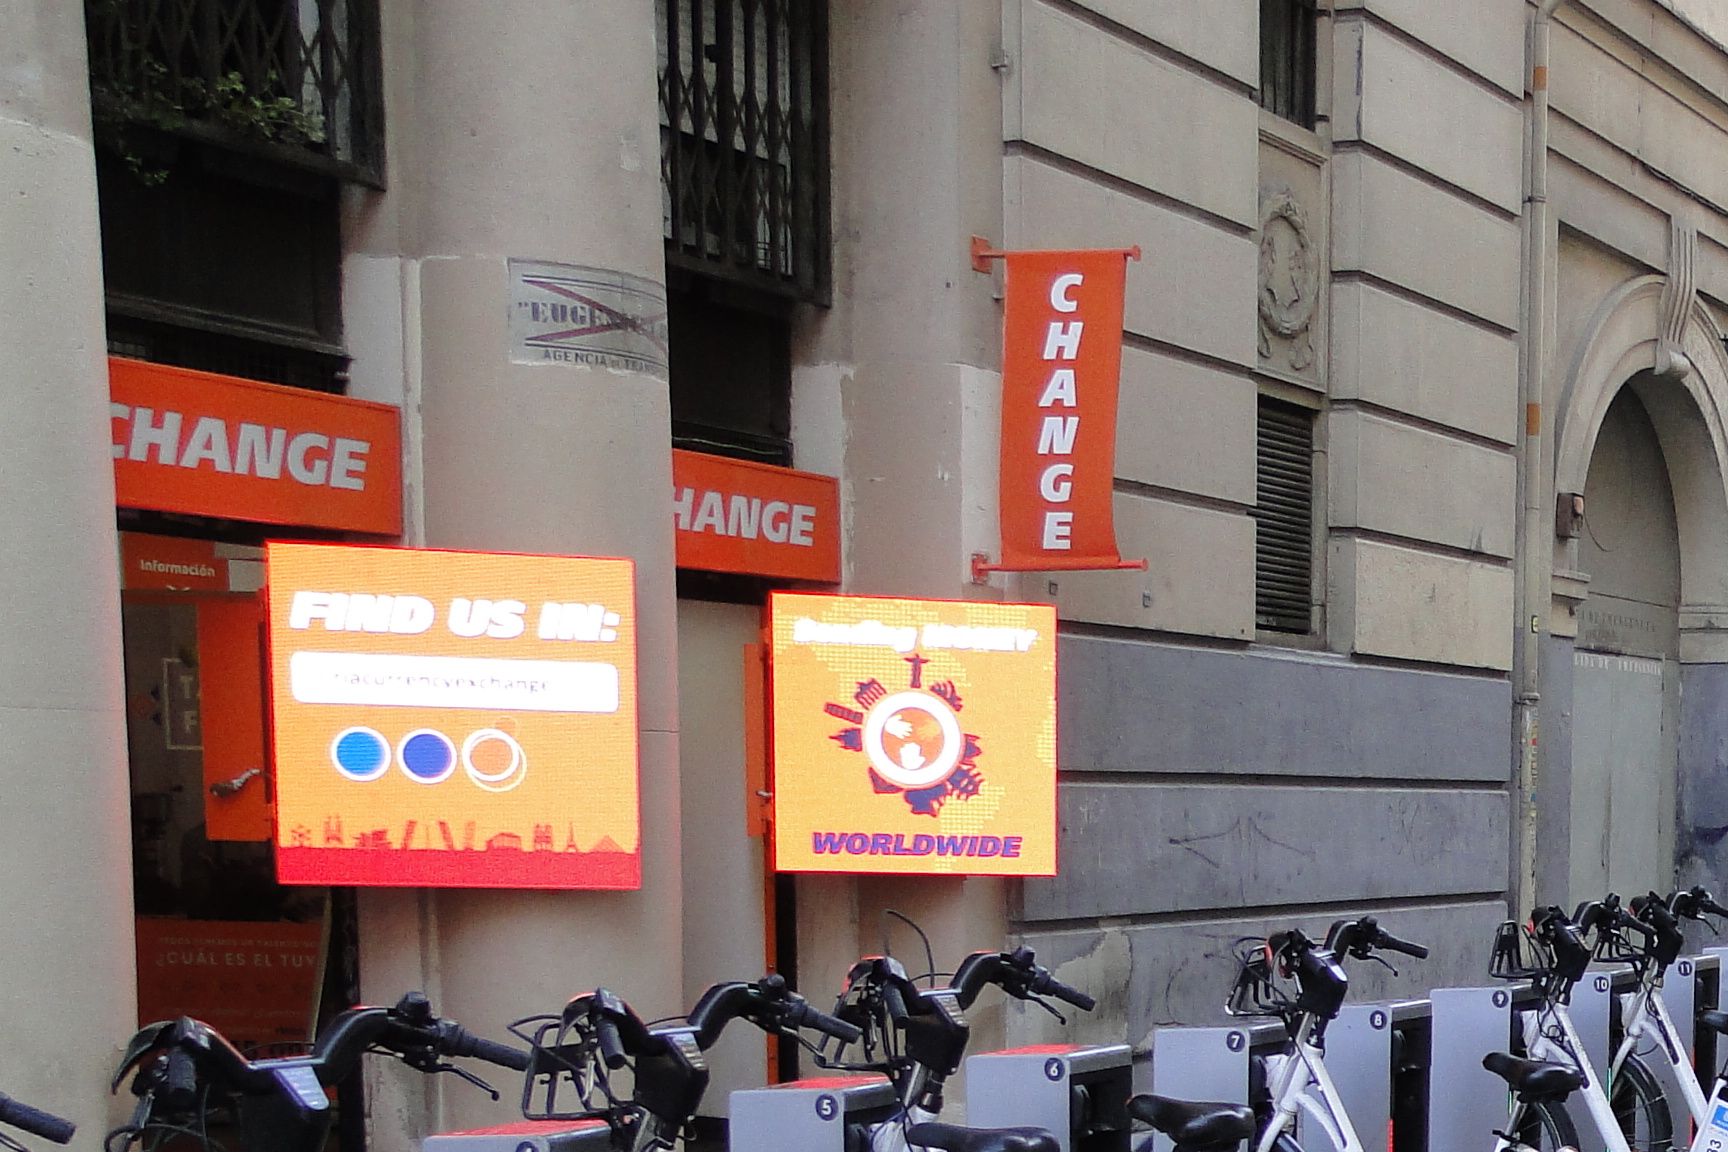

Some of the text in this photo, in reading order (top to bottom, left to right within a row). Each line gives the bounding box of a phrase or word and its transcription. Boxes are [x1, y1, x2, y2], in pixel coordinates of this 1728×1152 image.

[544, 349, 607, 366] AGENCIA
[1037, 273, 1084, 550] CHANGE
[673, 487, 816, 547] HANGE
[141, 558, 215, 577] Información
[289, 590, 435, 634] FIND
[448, 597, 527, 639] US
[812, 831, 1023, 858] WORLDWIDE
[225, 953, 245, 966] ES
[253, 954, 273, 967] EL
[1680, 961, 1690, 974] 11
[1596, 978, 1608, 990] 10
[1497, 992, 1505, 1006] 9
[1374, 1013, 1382, 1026] 8
[1231, 1034, 1240, 1048] 7
[1050, 1061, 1059, 1076] 6
[821, 1098, 832, 1115] 5
